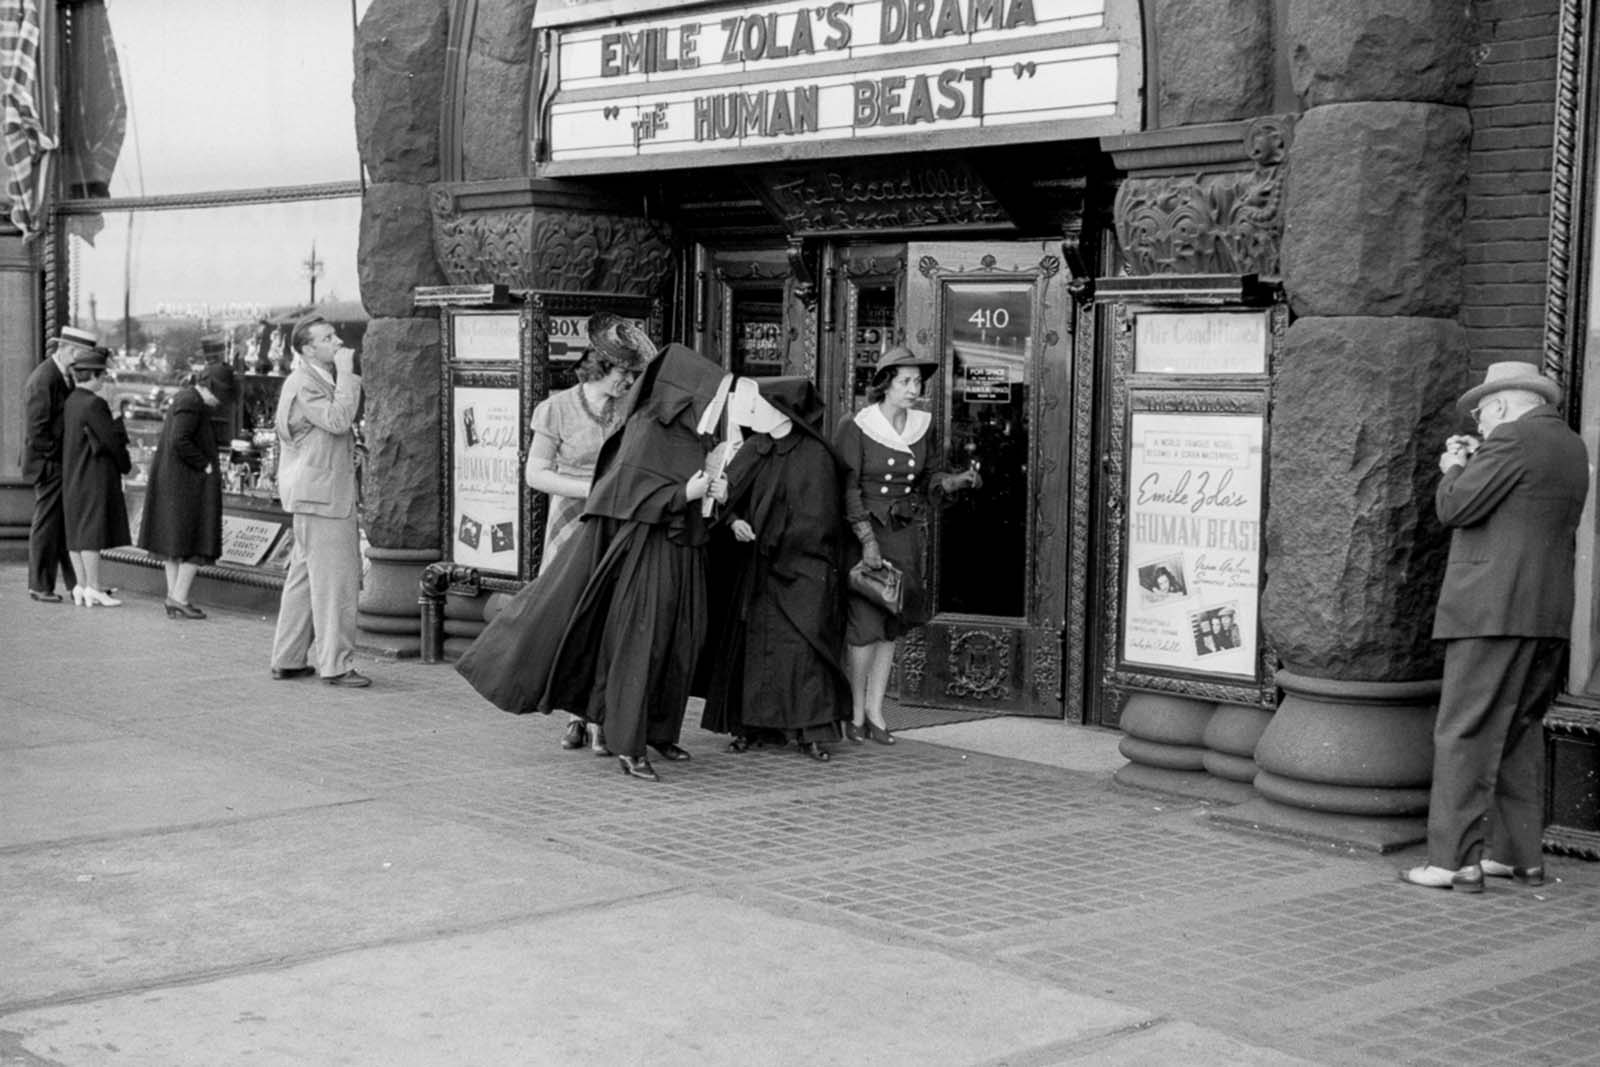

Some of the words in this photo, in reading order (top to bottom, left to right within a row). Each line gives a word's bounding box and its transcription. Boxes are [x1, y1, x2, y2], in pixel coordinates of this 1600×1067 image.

[601, 23, 701, 77] EMILE
[720, 2, 850, 64] ZOLA'S
[880, 0, 1037, 44] DRAMA
[694, 85, 818, 142] HUMAN
[549, 319, 580, 337] BOX
[968, 308, 1009, 328] 410
[1137, 470, 1188, 505] Emile
[1191, 468, 1247, 513] Zola's
[1135, 512, 1200, 548] HUMAN
[1206, 518, 1257, 551] BEAST
